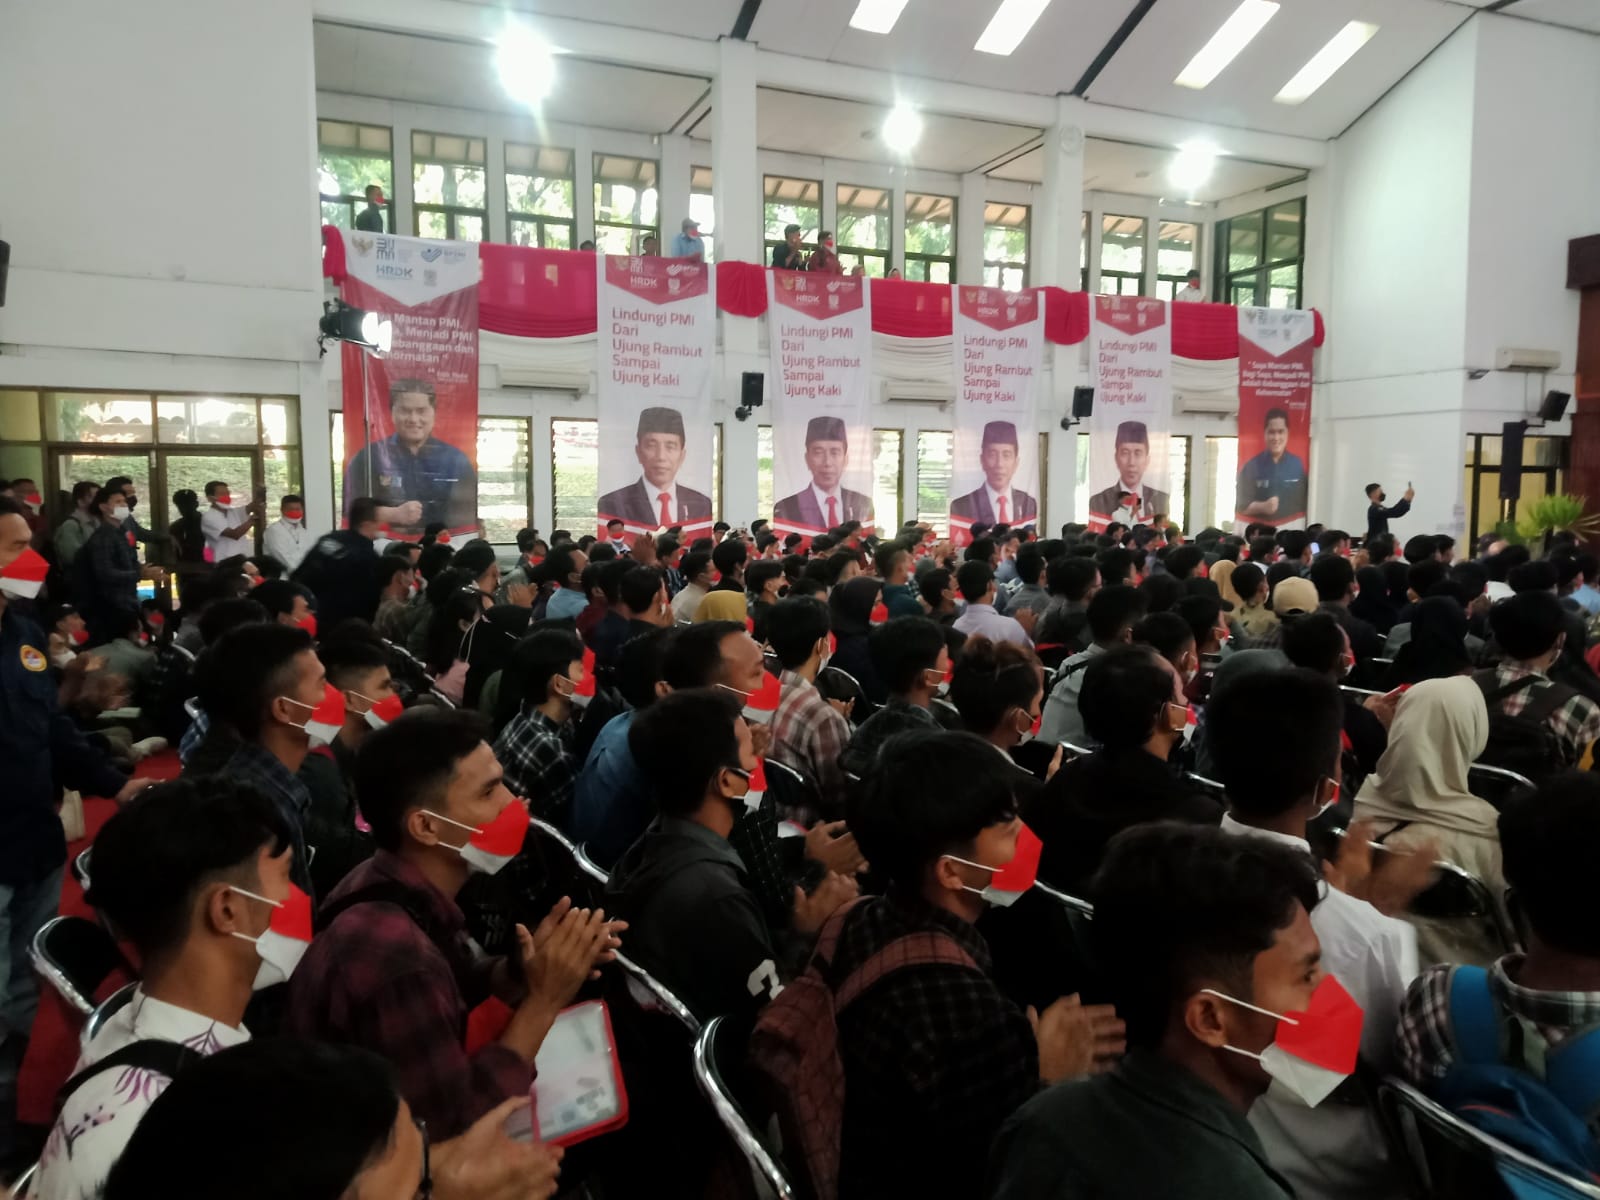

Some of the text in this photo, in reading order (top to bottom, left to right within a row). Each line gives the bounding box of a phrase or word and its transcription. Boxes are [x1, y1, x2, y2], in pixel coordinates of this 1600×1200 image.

[376, 264, 413, 278] HRDK
[630, 276, 656, 288] HRDK
[394, 313, 436, 327] Mantan
[613, 307, 695, 326] Lindungi PMI
[406, 327, 449, 341] Menjadi
[452, 331, 473, 342] PMI
[612, 323, 638, 336] Dari
[781, 324, 853, 341] Lindungi PMI
[454, 344, 474, 354] dan
[612, 338, 703, 357] Ujung Rambut
[782, 340, 804, 352] Dari
[964, 336, 1027, 350] Lindungi PMI
[1099, 340, 1157, 354] Lindungi PMI
[964, 348, 984, 360] Dari
[1099, 353, 1117, 363] Dari
[613, 354, 660, 371] Sampai
[782, 354, 861, 370] Ujung Rambut
[784, 369, 824, 383] Sampai
[964, 362, 1033, 377] Ujung Rambut
[1099, 366, 1162, 380] Ujung Rambut
[612, 369, 679, 388] Ujung Kaki
[964, 376, 1000, 390] Sampai
[1100, 378, 1132, 392] Sampai
[784, 383, 841, 399] Ujung Kaki
[963, 389, 1015, 405] Ujung Kaki
[1100, 392, 1147, 406] Ujung Kaki
